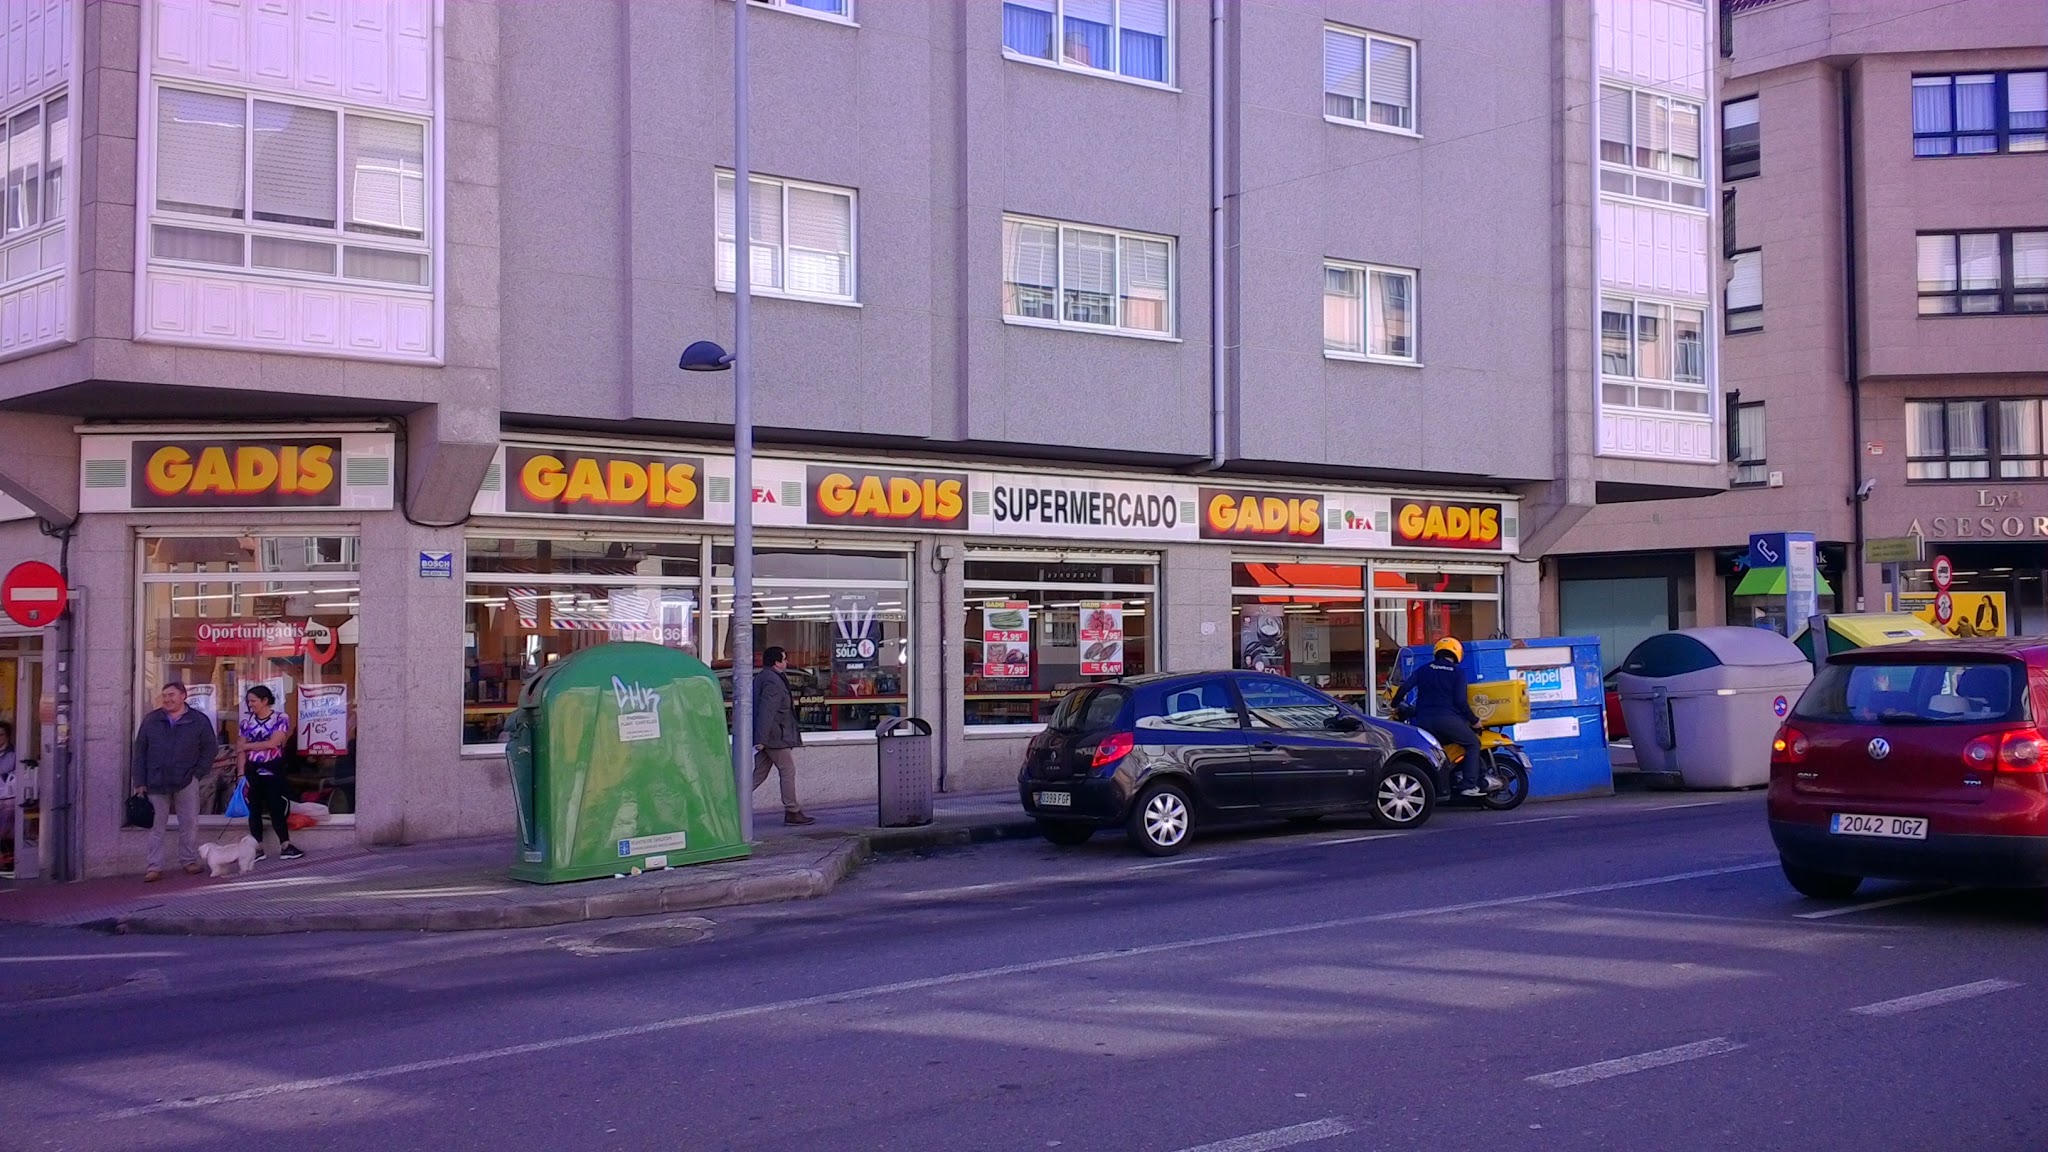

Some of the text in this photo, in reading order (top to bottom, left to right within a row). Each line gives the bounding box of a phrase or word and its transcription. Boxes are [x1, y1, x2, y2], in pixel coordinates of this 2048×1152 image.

[145, 445, 333, 496] GADIS
[519, 455, 697, 509] GADIS
[752, 488, 777, 503] FA
[817, 473, 963, 521] GADIS
[993, 486, 1176, 529] SUPERMERCADO
[1208, 493, 1321, 536] GADIS
[1399, 503, 1498, 542] GADIS
[1527, 667, 1560, 688] papel
[800, 696, 824, 704] GADIS
[1843, 816, 1923, 837] 2042 DGZ
